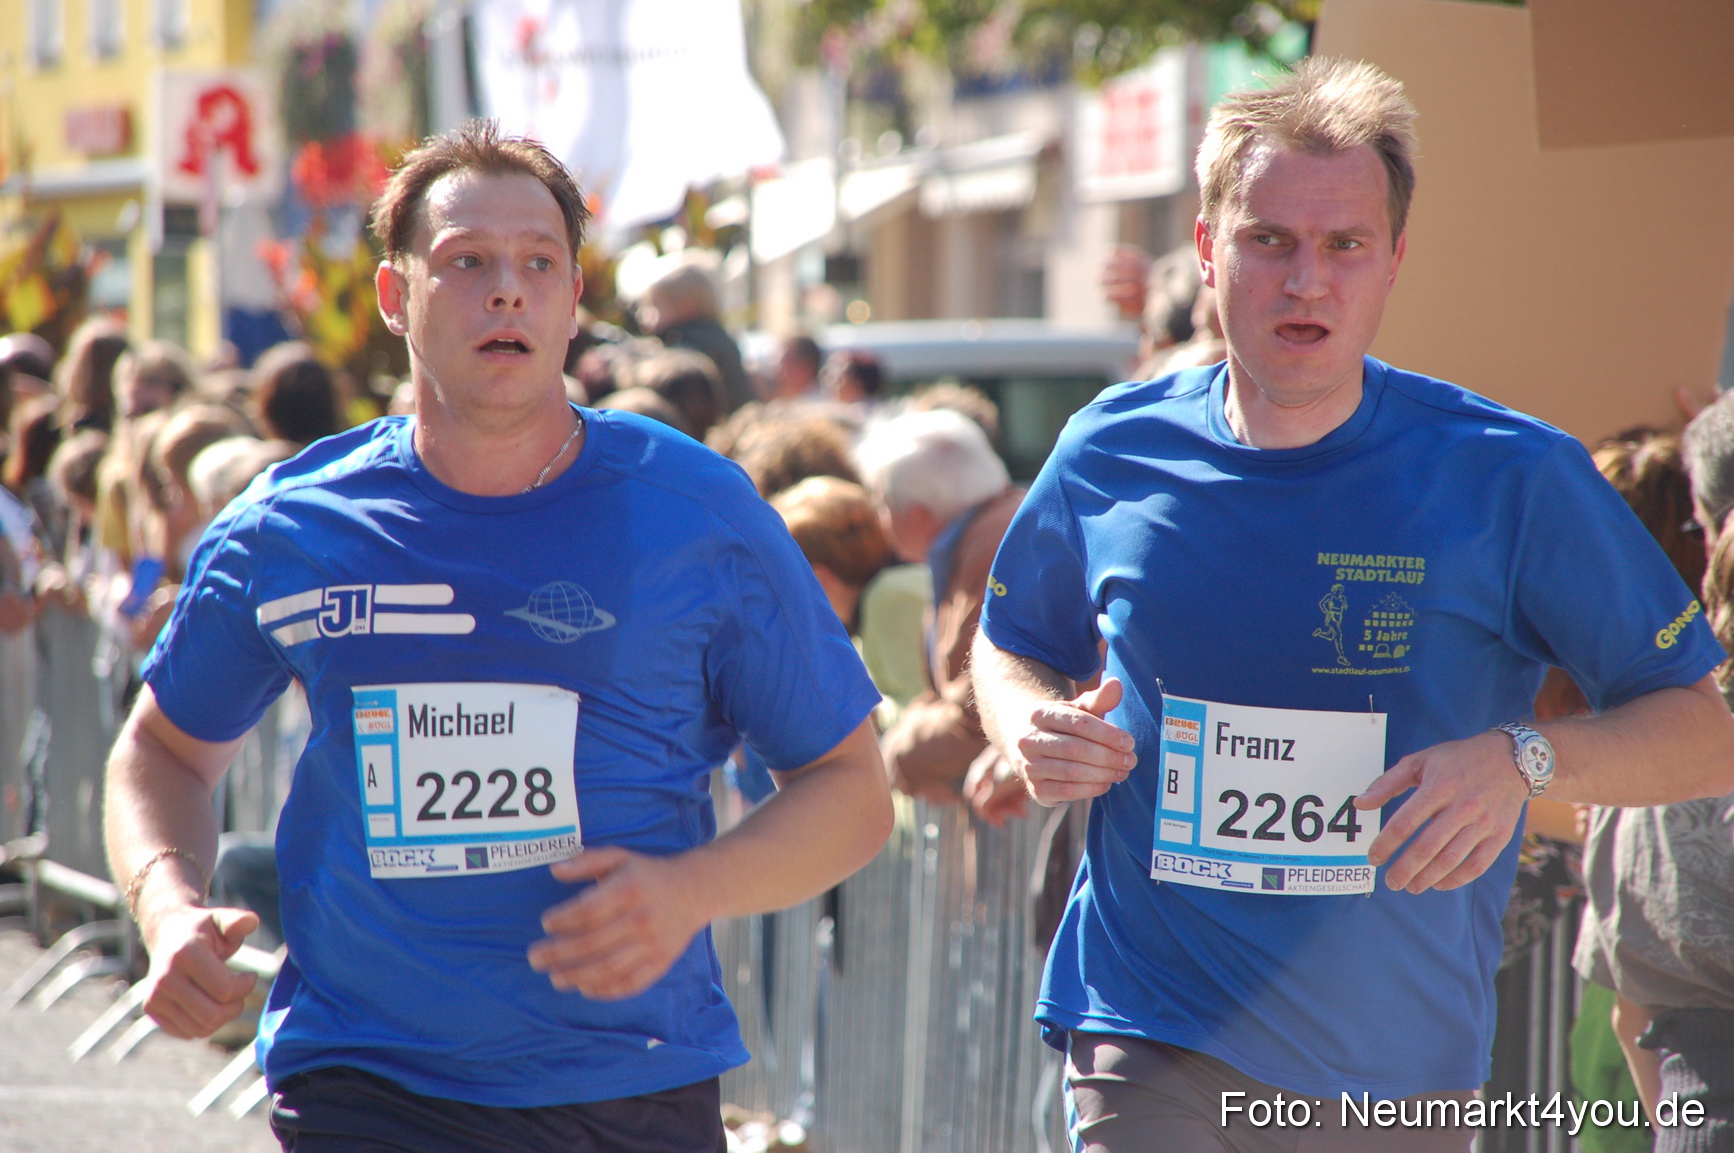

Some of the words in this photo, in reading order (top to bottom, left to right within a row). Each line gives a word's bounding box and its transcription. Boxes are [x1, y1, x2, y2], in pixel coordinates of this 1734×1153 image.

[1317, 552, 1426, 569] NEUMARKTER
[1335, 567, 1426, 585] STADTLAUF
[1364, 629, 1372, 641] 5
[1376, 630, 1409, 642] Jahre
[407, 701, 516, 739] Michael
[1165, 717, 1200, 731] BRUCK
[1175, 730, 1199, 742] BÜGL
[1215, 721, 1296, 762] Franz
[366, 762, 378, 789] A
[1166, 768, 1179, 795] B
[415, 766, 557, 823] 2228
[1216, 788, 1363, 843] 2264
[370, 848, 436, 868] BOCK
[490, 835, 577, 860] PFLEIDERER
[1154, 853, 1232, 881] BOCK
[1288, 867, 1371, 882] PFLEIDERER
[1287, 882, 1370, 892] AKTIENGESELLSCHAFT
